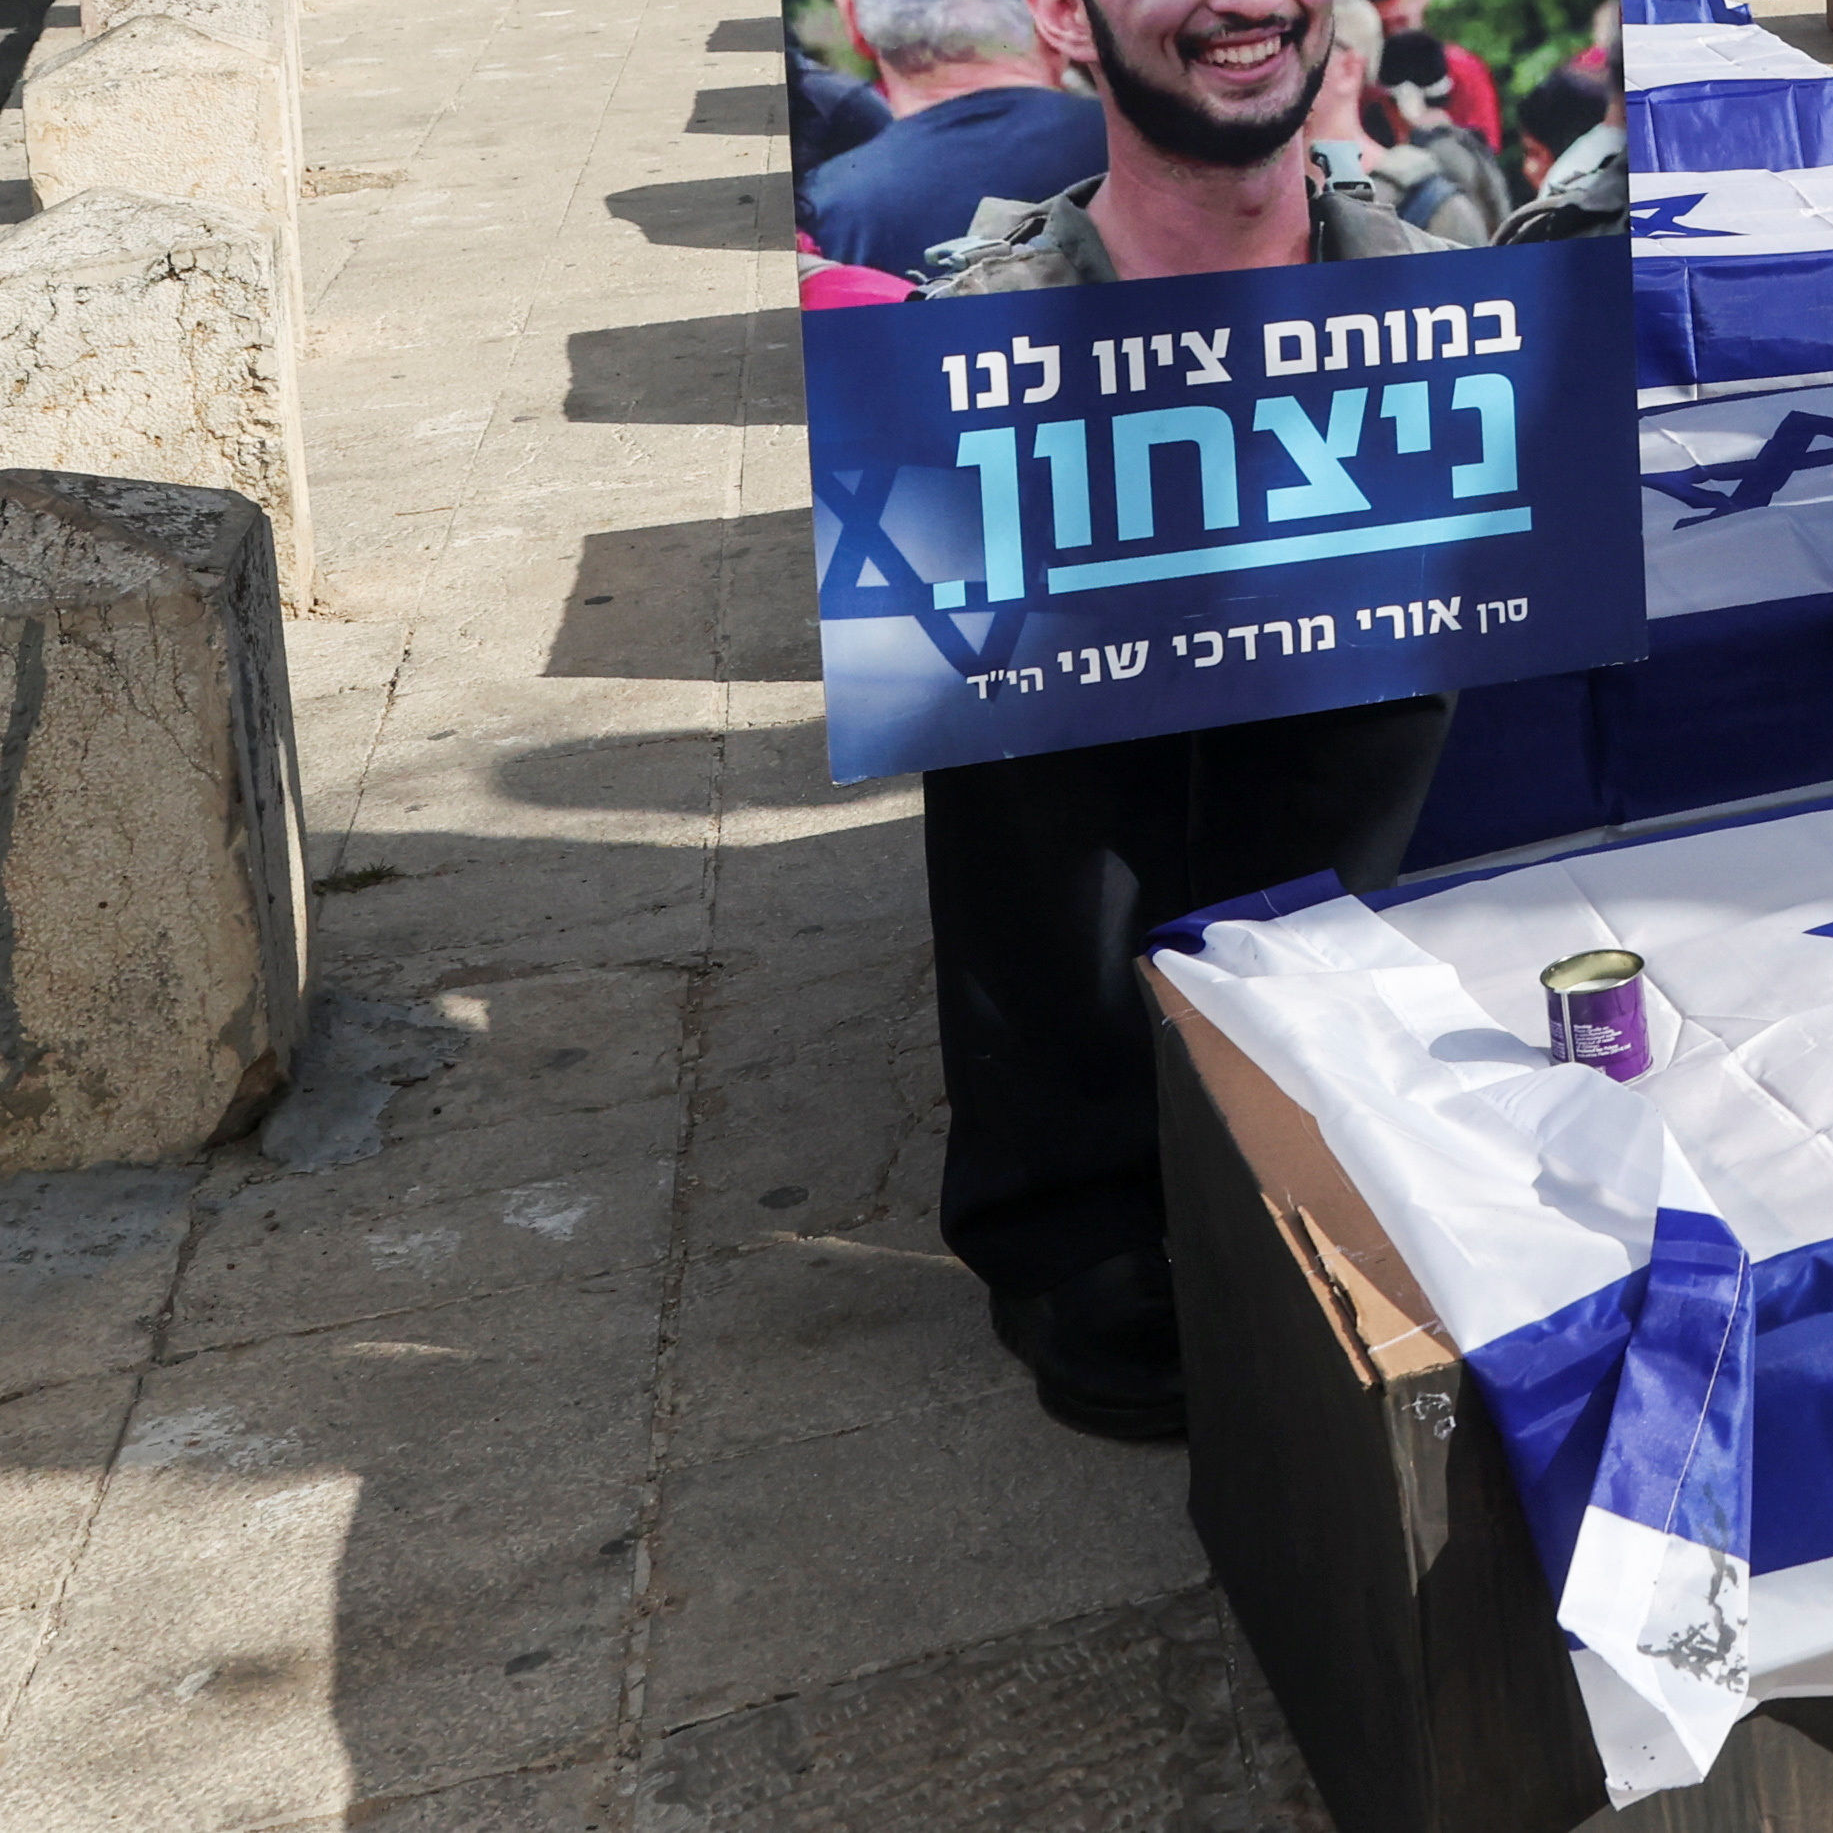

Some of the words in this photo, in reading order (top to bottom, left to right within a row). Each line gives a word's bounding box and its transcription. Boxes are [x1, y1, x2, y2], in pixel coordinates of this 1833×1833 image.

[1090, 327, 1233, 397] ציוו
[1263, 298, 1523, 378] במותם
[941, 335, 1061, 412] לנו
[932, 372, 1519, 610] ניצחון.
[1171, 614, 1337, 669] מרדכי
[1355, 595, 1464, 644] אורי
[1476, 596, 1530, 634] סרן
[1056, 639, 1150, 687] שני
